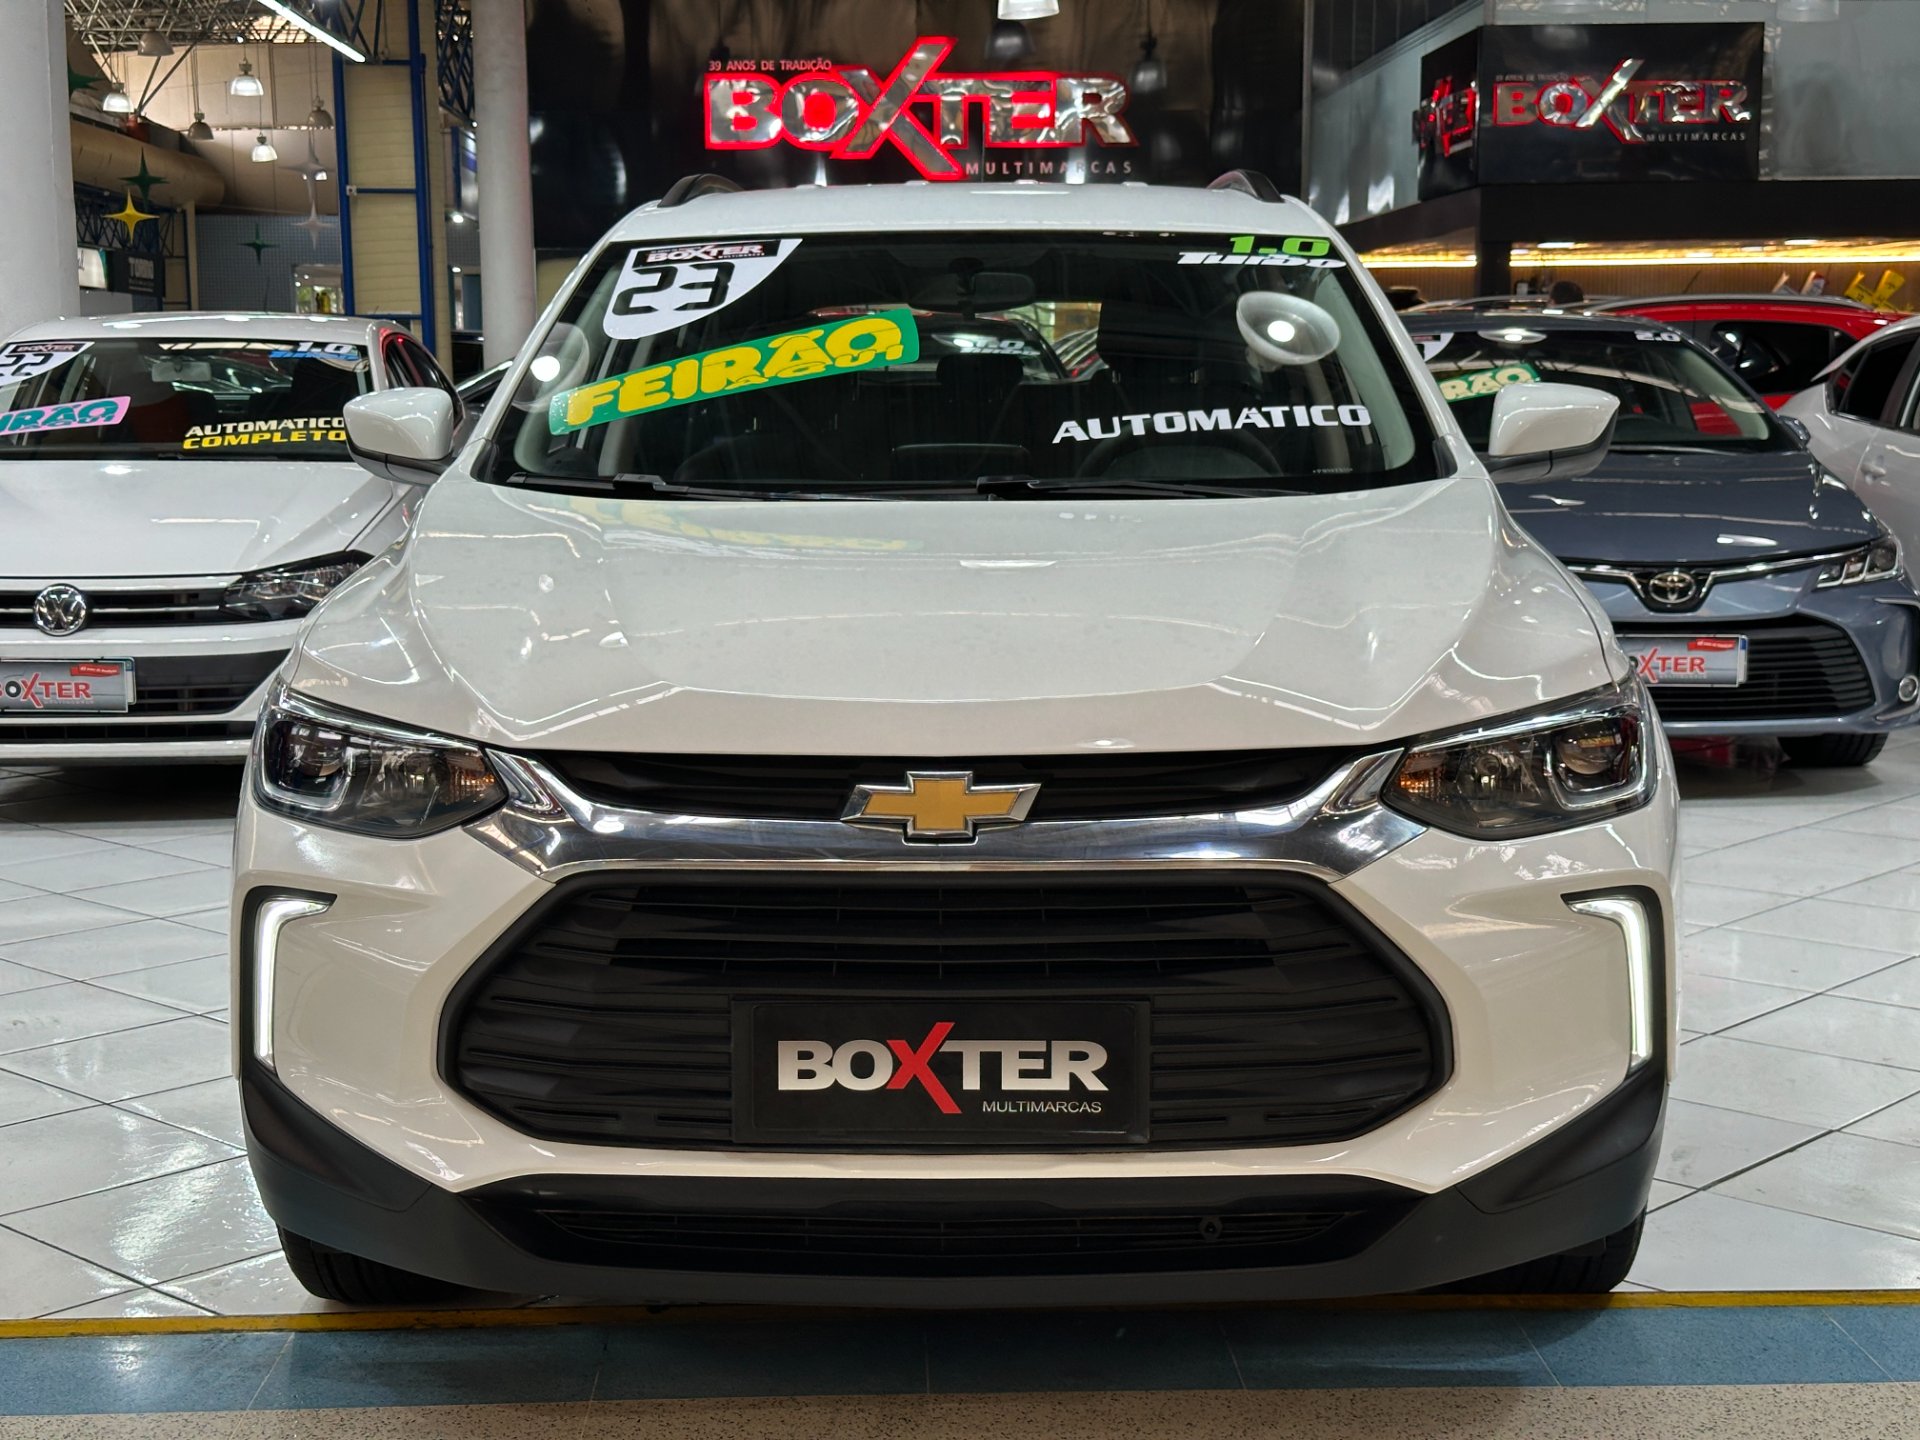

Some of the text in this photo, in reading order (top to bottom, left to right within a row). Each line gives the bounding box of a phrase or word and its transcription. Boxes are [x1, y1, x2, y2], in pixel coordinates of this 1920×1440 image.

[709, 58, 832, 72] 39 ANOS DE TRADIÇÃO
[704, 36, 1138, 181] BOXTER
[1493, 58, 1751, 144] BOXTER
[1646, 132, 1745, 142] MULTIMARCAS
[966, 161, 1132, 175] MULTIMARCAS
[646, 244, 765, 262] BOXTER
[1230, 236, 1330, 256] 1.0
[612, 261, 736, 317] 23
[567, 318, 903, 426] FEIRÃO
[183, 430, 347, 449] COMPLETO
[0, 672, 93, 709] OXTER
[778, 1022, 1109, 1114] BOXTER
[983, 1101, 1102, 1114] MULTIMARCAS
